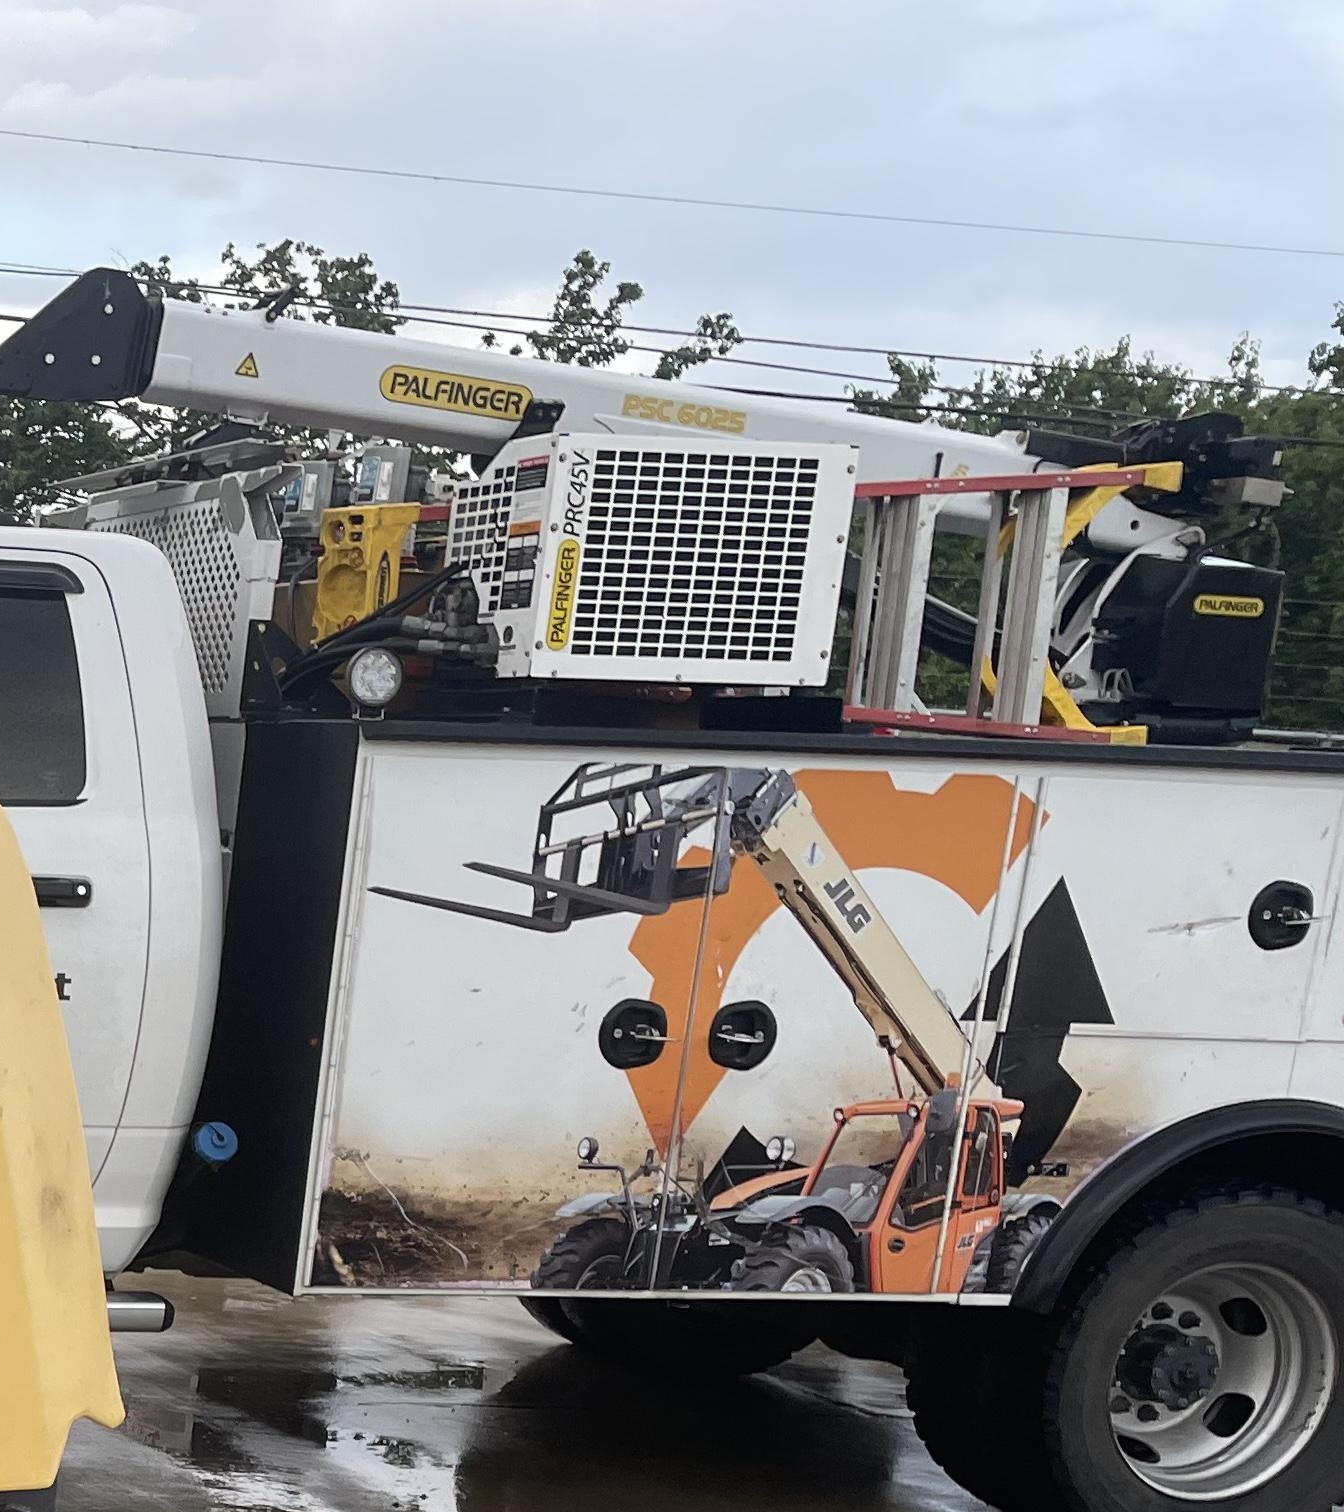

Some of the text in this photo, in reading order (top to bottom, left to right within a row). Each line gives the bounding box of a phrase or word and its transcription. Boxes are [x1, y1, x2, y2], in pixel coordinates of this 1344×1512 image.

[389, 371, 524, 415] PALFINGER
[623, 393, 747, 433] PSC 6025
[563, 450, 591, 537] PRC45V
[550, 547, 576, 643] PALFINGER
[823, 878, 872, 934] JLG
